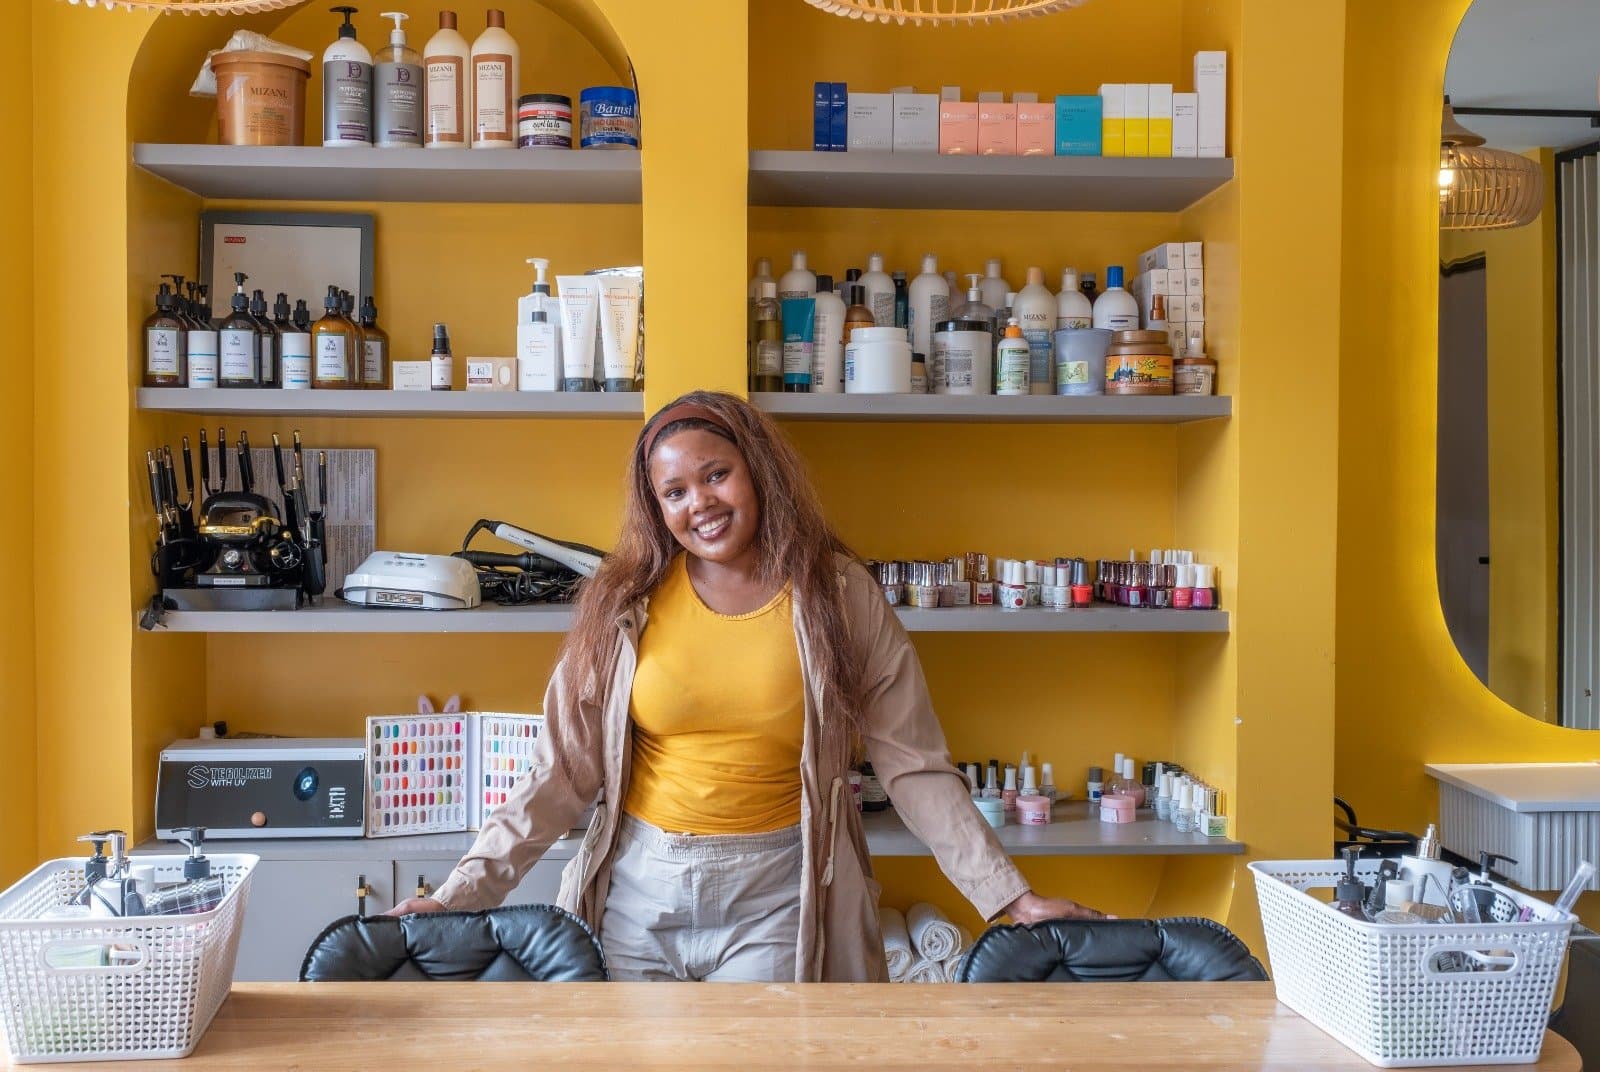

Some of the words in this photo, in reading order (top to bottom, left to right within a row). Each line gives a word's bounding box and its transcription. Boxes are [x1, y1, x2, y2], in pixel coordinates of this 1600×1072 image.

[595, 103, 633, 116] Bamsi
[210, 779, 232, 787] WITH
[233, 779, 247, 787] UV
